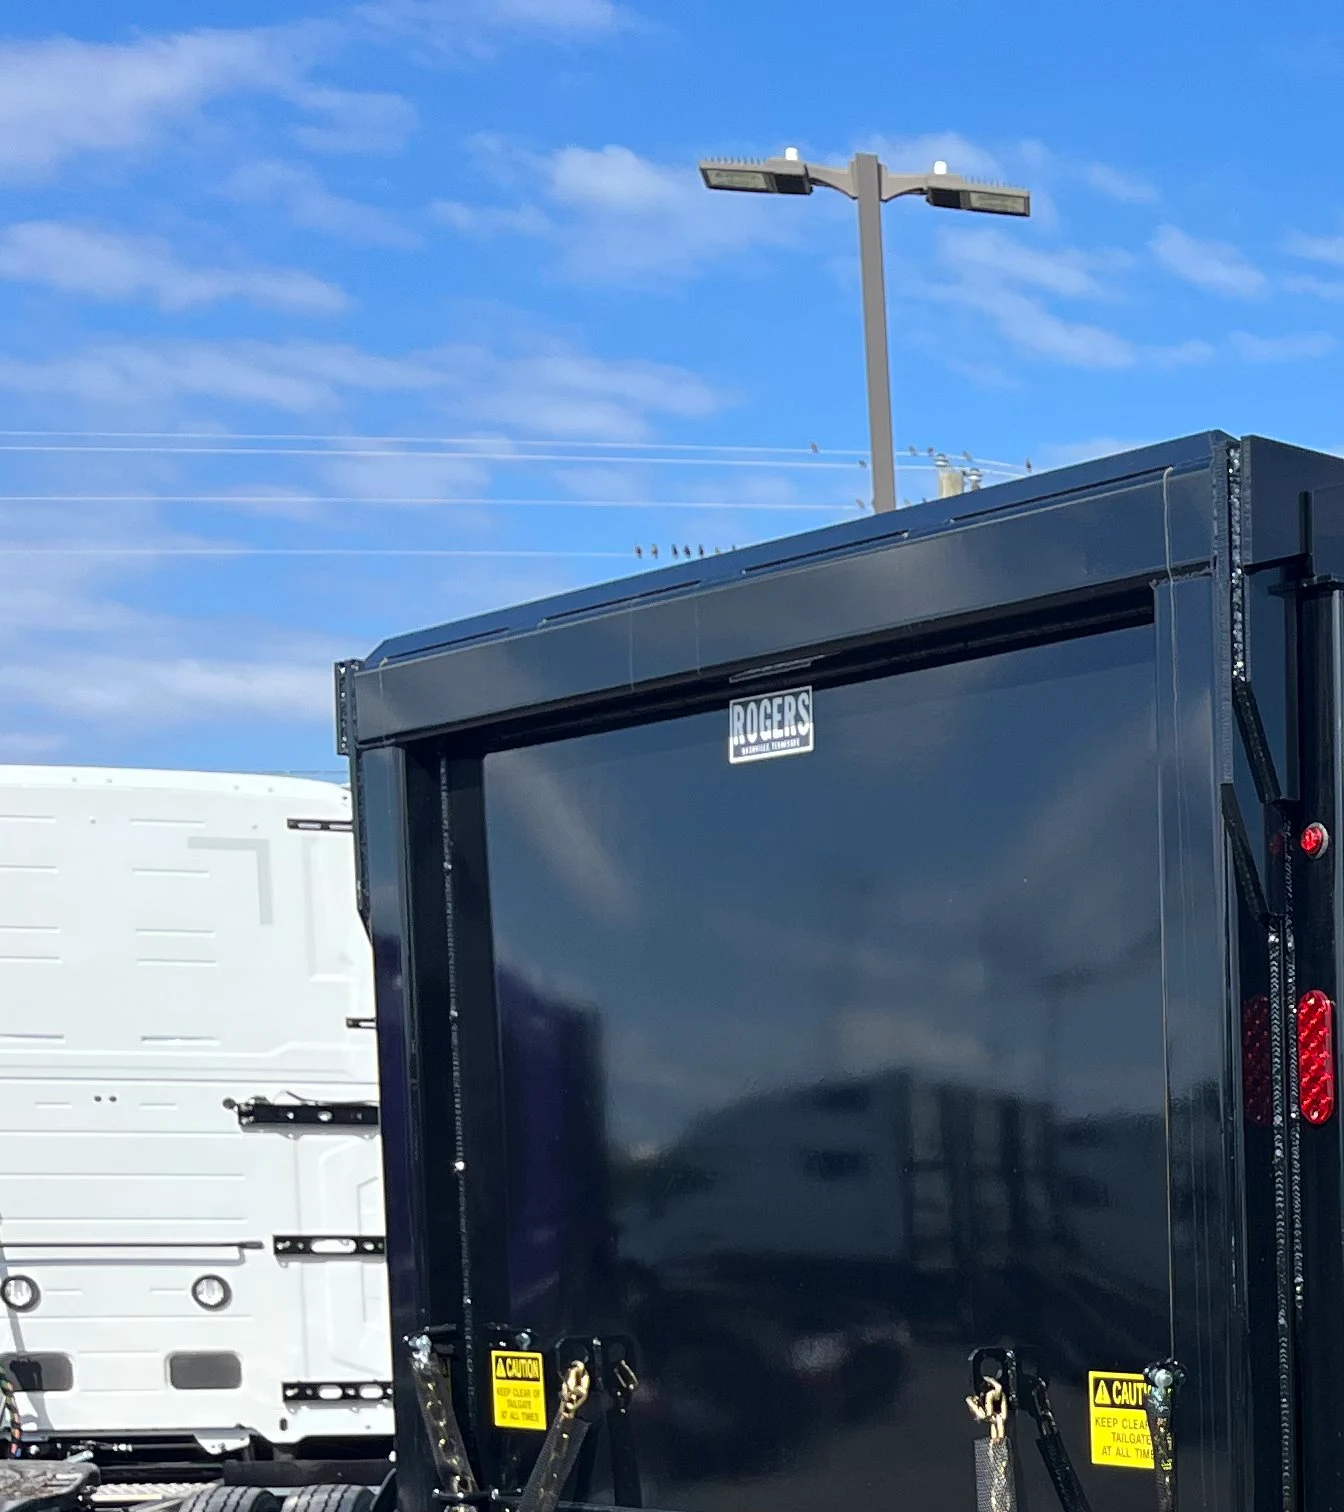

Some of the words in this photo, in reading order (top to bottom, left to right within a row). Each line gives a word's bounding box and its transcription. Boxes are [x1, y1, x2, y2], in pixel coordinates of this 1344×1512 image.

[733, 692, 810, 746] ROGERS
[506, 1357, 540, 1379] CAUTION
[1095, 1416, 1118, 1428] KEEP
[1102, 1445, 1112, 1456] AT
[1115, 1446, 1131, 1458] ALL
